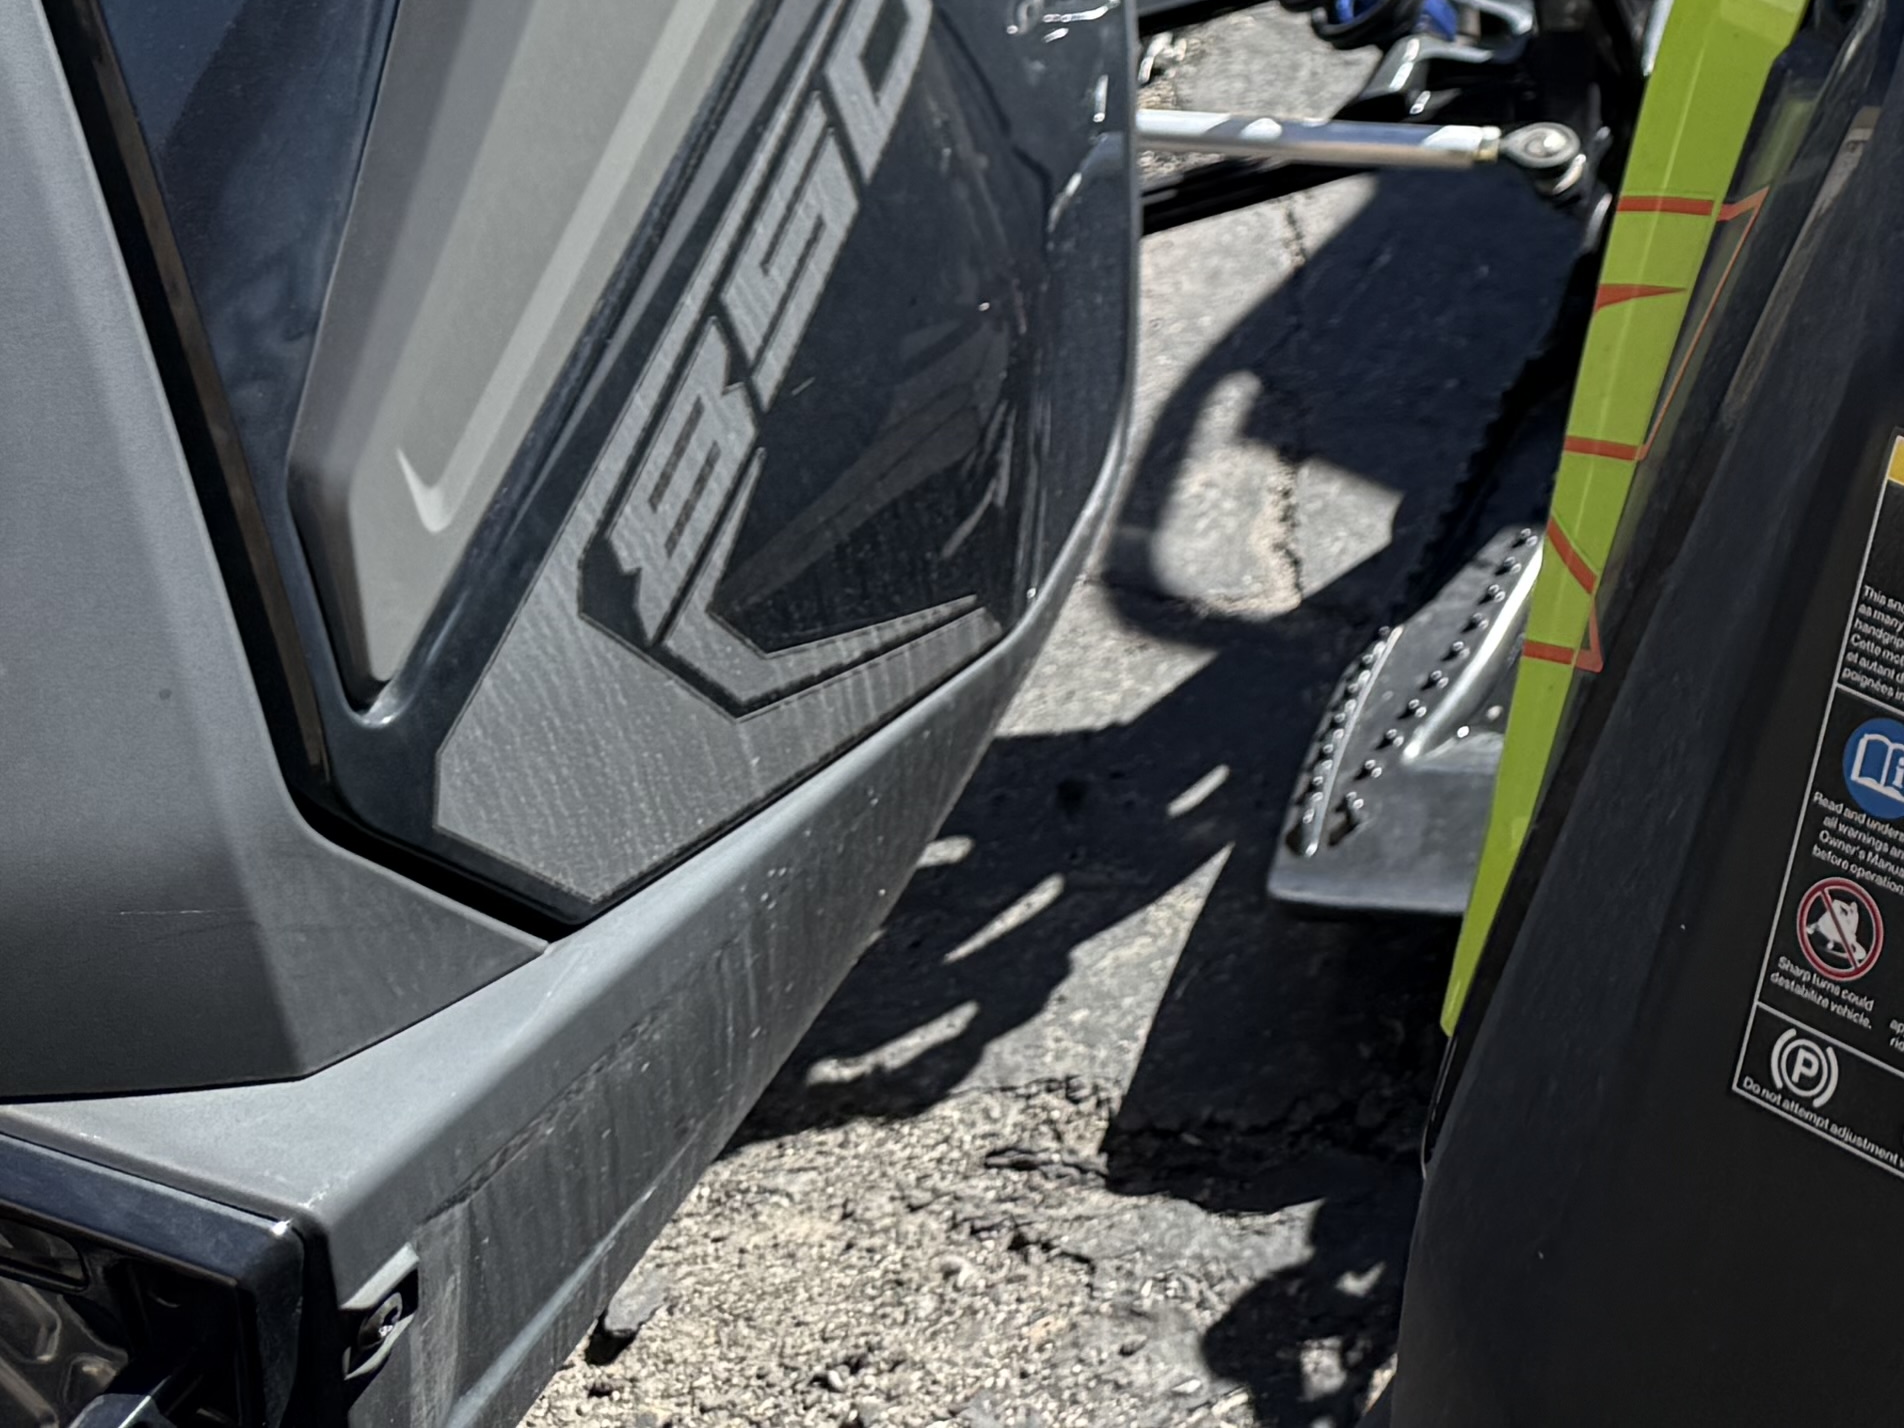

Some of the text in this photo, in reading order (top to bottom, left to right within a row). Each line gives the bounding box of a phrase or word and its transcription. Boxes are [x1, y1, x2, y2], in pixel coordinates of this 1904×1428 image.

[1862, 584, 1887, 605] This
[1857, 602, 1872, 617] as
[1871, 609, 1904, 634] many
[1812, 789, 1844, 815] Read
[1843, 804, 1866, 825] and
[1822, 811, 1839, 830] all
[1837, 819, 1890, 855] warnings
[1811, 842, 1849, 871] before
[1776, 954, 1874, 1012] Sharp turns could
[1742, 1074, 1761, 1095] Do
[1760, 1085, 1782, 1106] not
[1781, 1096, 1830, 1132] attempt
[1829, 1120, 1899, 1166] adjustment
